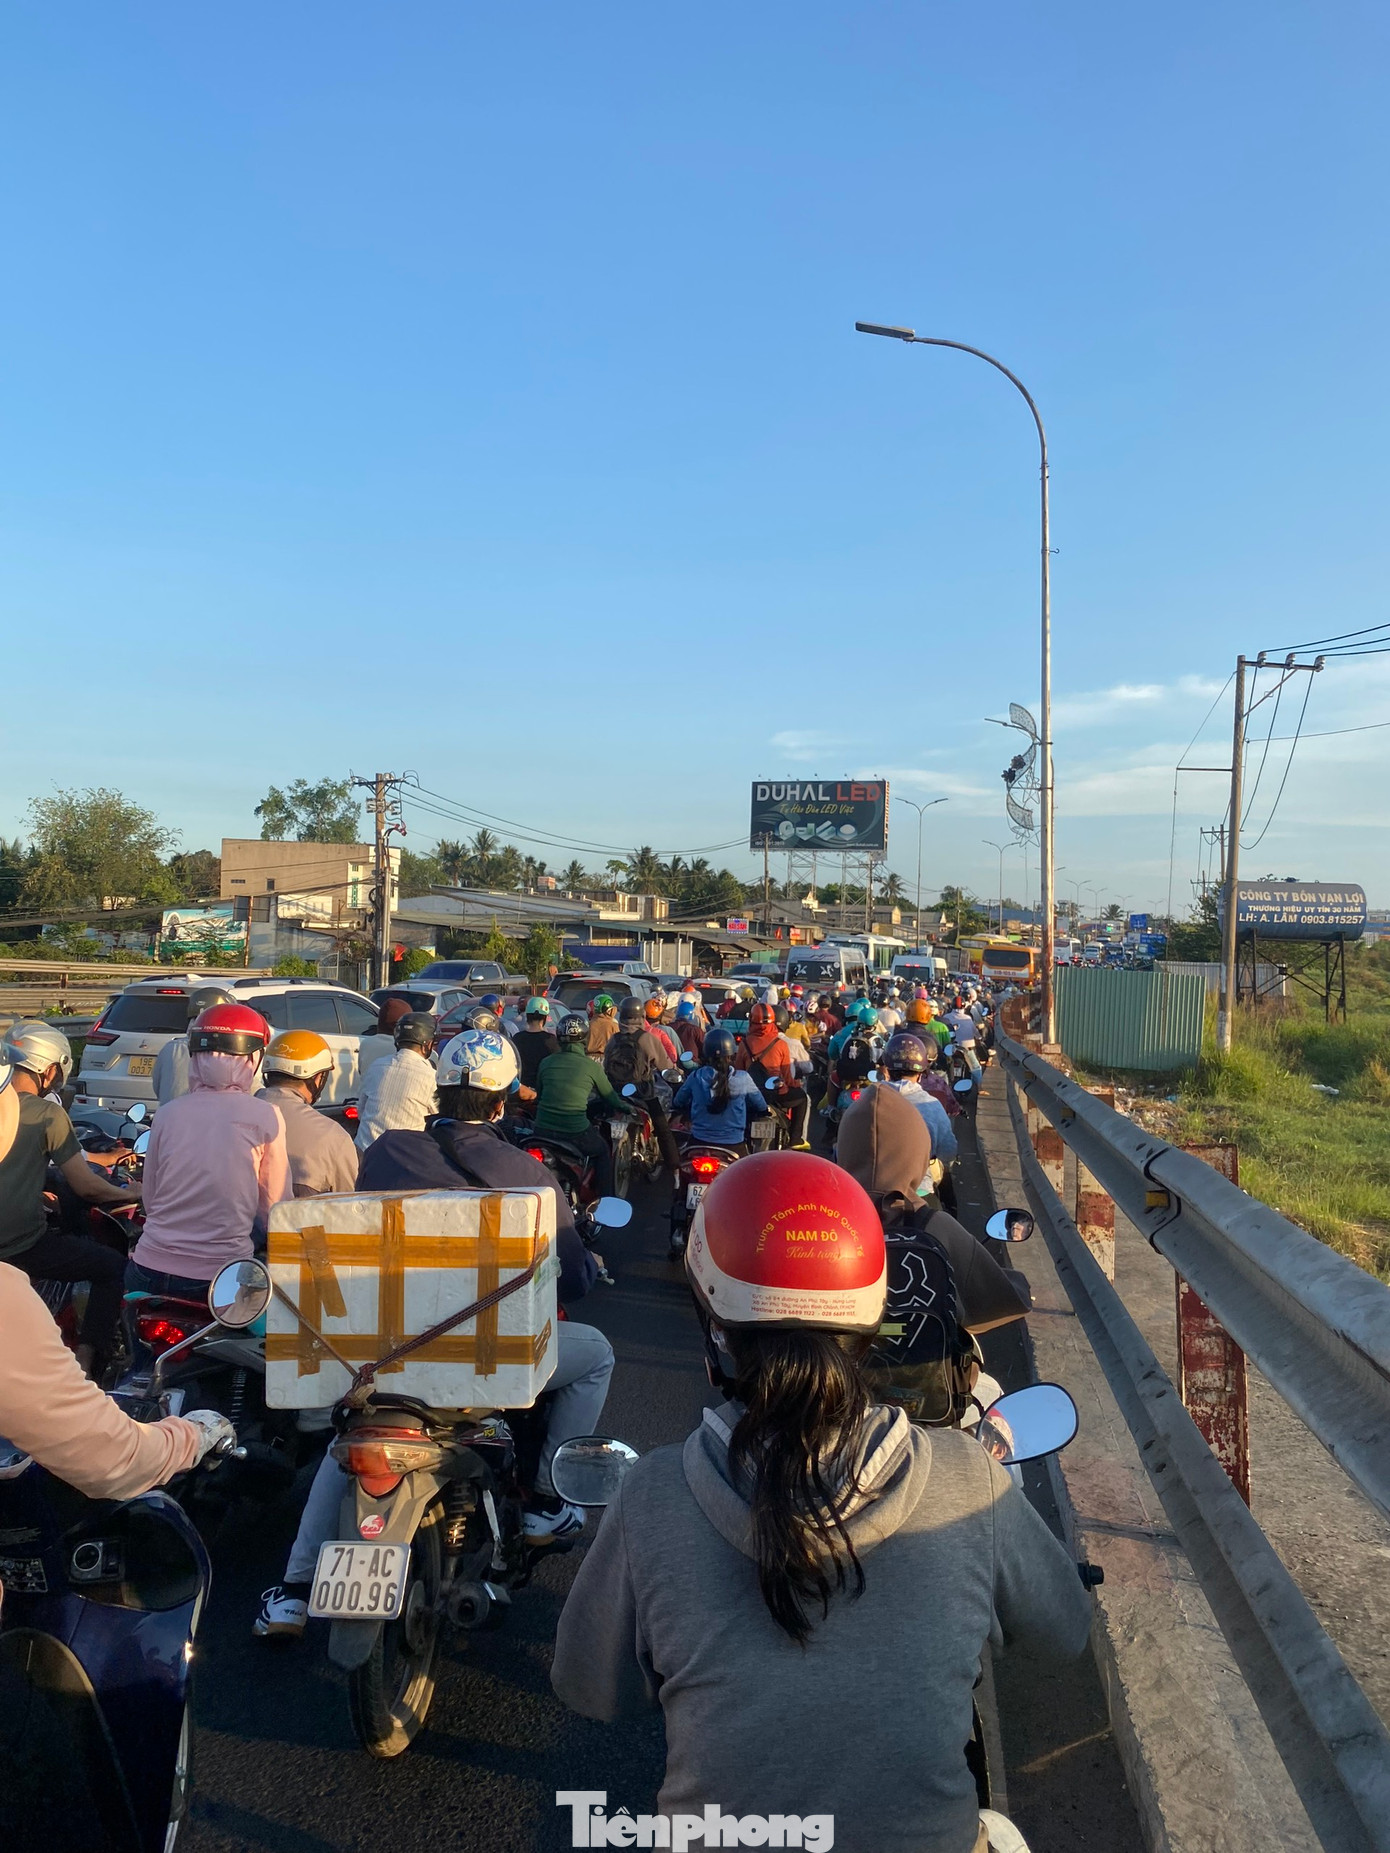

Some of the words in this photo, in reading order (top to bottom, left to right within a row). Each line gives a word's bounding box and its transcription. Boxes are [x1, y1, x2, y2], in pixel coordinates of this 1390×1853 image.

[756, 784, 830, 802] DUHAL
[836, 784, 880, 802] LED
[820, 804, 838, 814] LED
[1240, 889, 1272, 901] CÔNG
[1274, 892, 1288, 902] TY
[1318, 894, 1342, 906] VẠN
[1345, 893, 1364, 906] LỢI
[1282, 905, 1302, 913] HIỆU
[1239, 912, 1257, 922] LH:
[1260, 913, 1270, 922] A.
[1274, 912, 1297, 923] LÂM
[1300, 915, 1364, 924] 0903.815257
[756, 1222, 774, 1254] Trung
[771, 1206, 796, 1223] Tâm
[798, 1202, 816, 1212] Anh
[820, 1204, 841, 1219] Ngữ
[840, 1216, 859, 1242] Quốc
[786, 1230, 818, 1242] NAM
[820, 1229, 838, 1242] ĐÔ
[316, 1580, 398, 1612] 000.96
